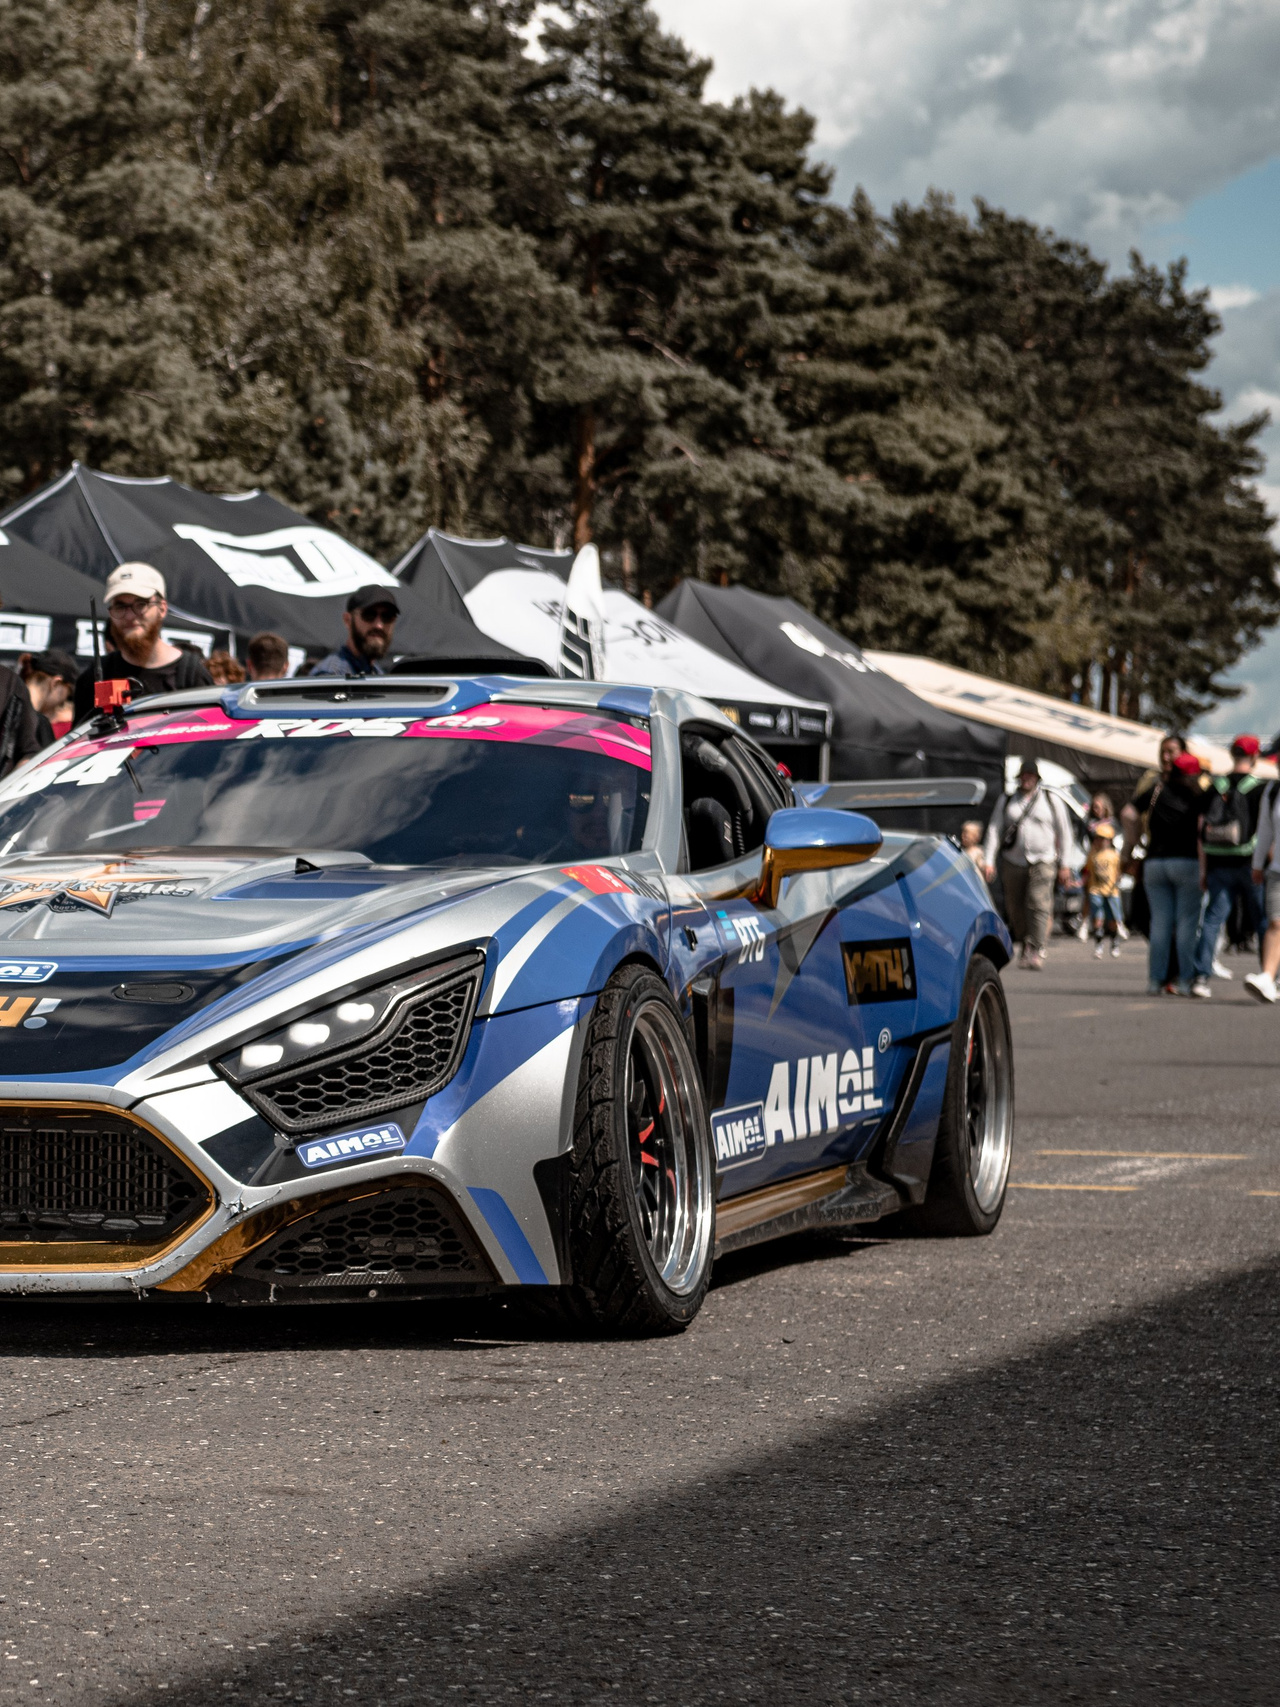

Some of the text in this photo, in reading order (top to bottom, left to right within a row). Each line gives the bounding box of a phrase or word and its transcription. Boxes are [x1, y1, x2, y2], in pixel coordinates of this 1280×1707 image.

[236, 715, 505, 739] RDS GP
[99, 880, 196, 897] STARS
[764, 1047, 883, 1147] AIMOL
[307, 1129, 400, 1163] AIMOL
[716, 1115, 764, 1161] AIMOL
